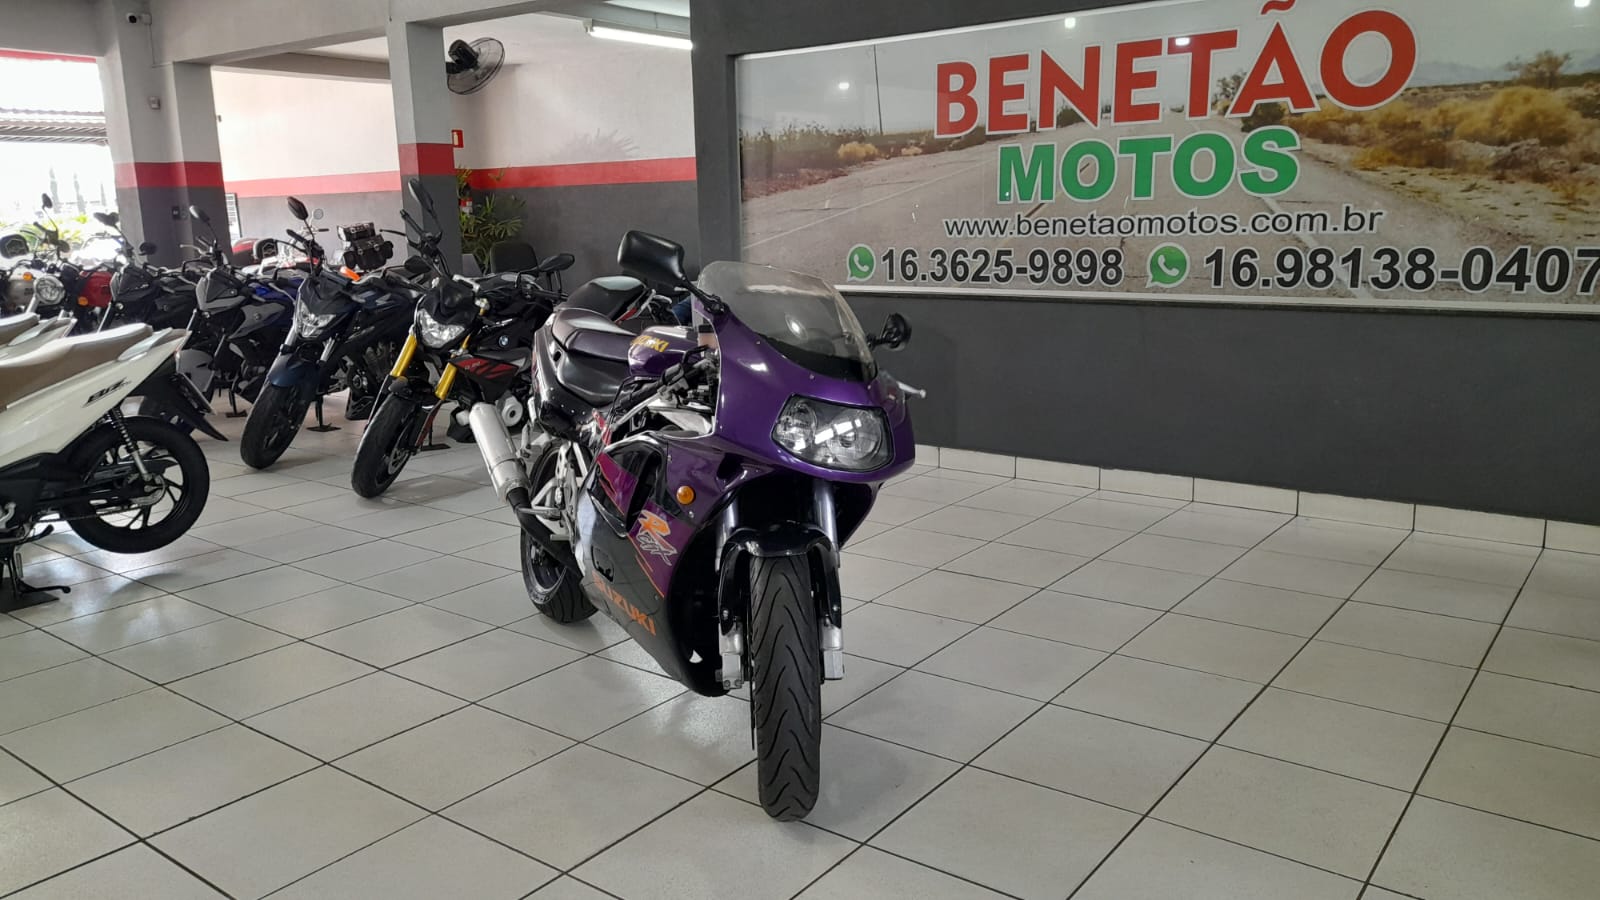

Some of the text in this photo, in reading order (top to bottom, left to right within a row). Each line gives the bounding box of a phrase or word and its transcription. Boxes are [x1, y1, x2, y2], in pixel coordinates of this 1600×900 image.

[934, 0, 1417, 137] BENETÃO
[998, 126, 1301, 202] MOTOS
[944, 205, 1384, 237] www.benetaomotos.com.br
[880, 248, 1124, 285] 16.3625-9898
[1203, 246, 1600, 294] 16.98138-0407
[591, 569, 657, 637] SUZUKI
